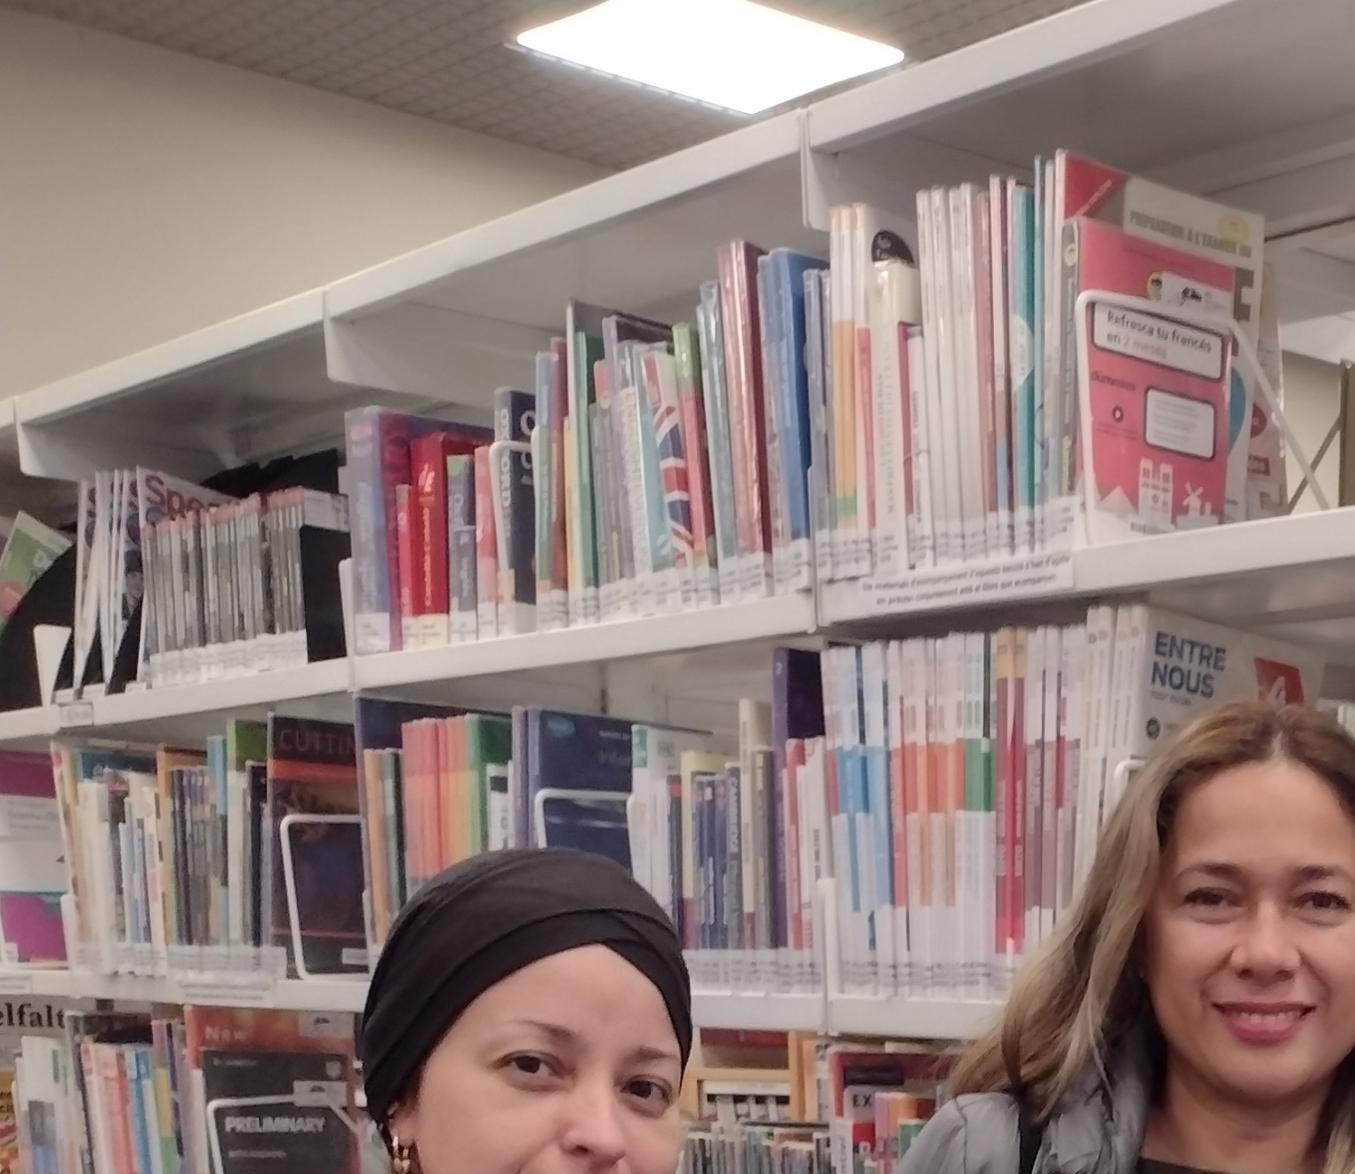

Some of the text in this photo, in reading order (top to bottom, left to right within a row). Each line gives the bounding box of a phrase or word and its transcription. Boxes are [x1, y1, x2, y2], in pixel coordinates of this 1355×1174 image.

[1106, 332, 1120, 344] en
[1107, 310, 1154, 337] Refresca
[1156, 326, 1169, 341] tu
[1155, 631, 1226, 672] ENTRE
[1152, 661, 1215, 699] NOUS
[205, 1026, 248, 1042] New
[225, 1116, 327, 1135] PRELIMINARY
